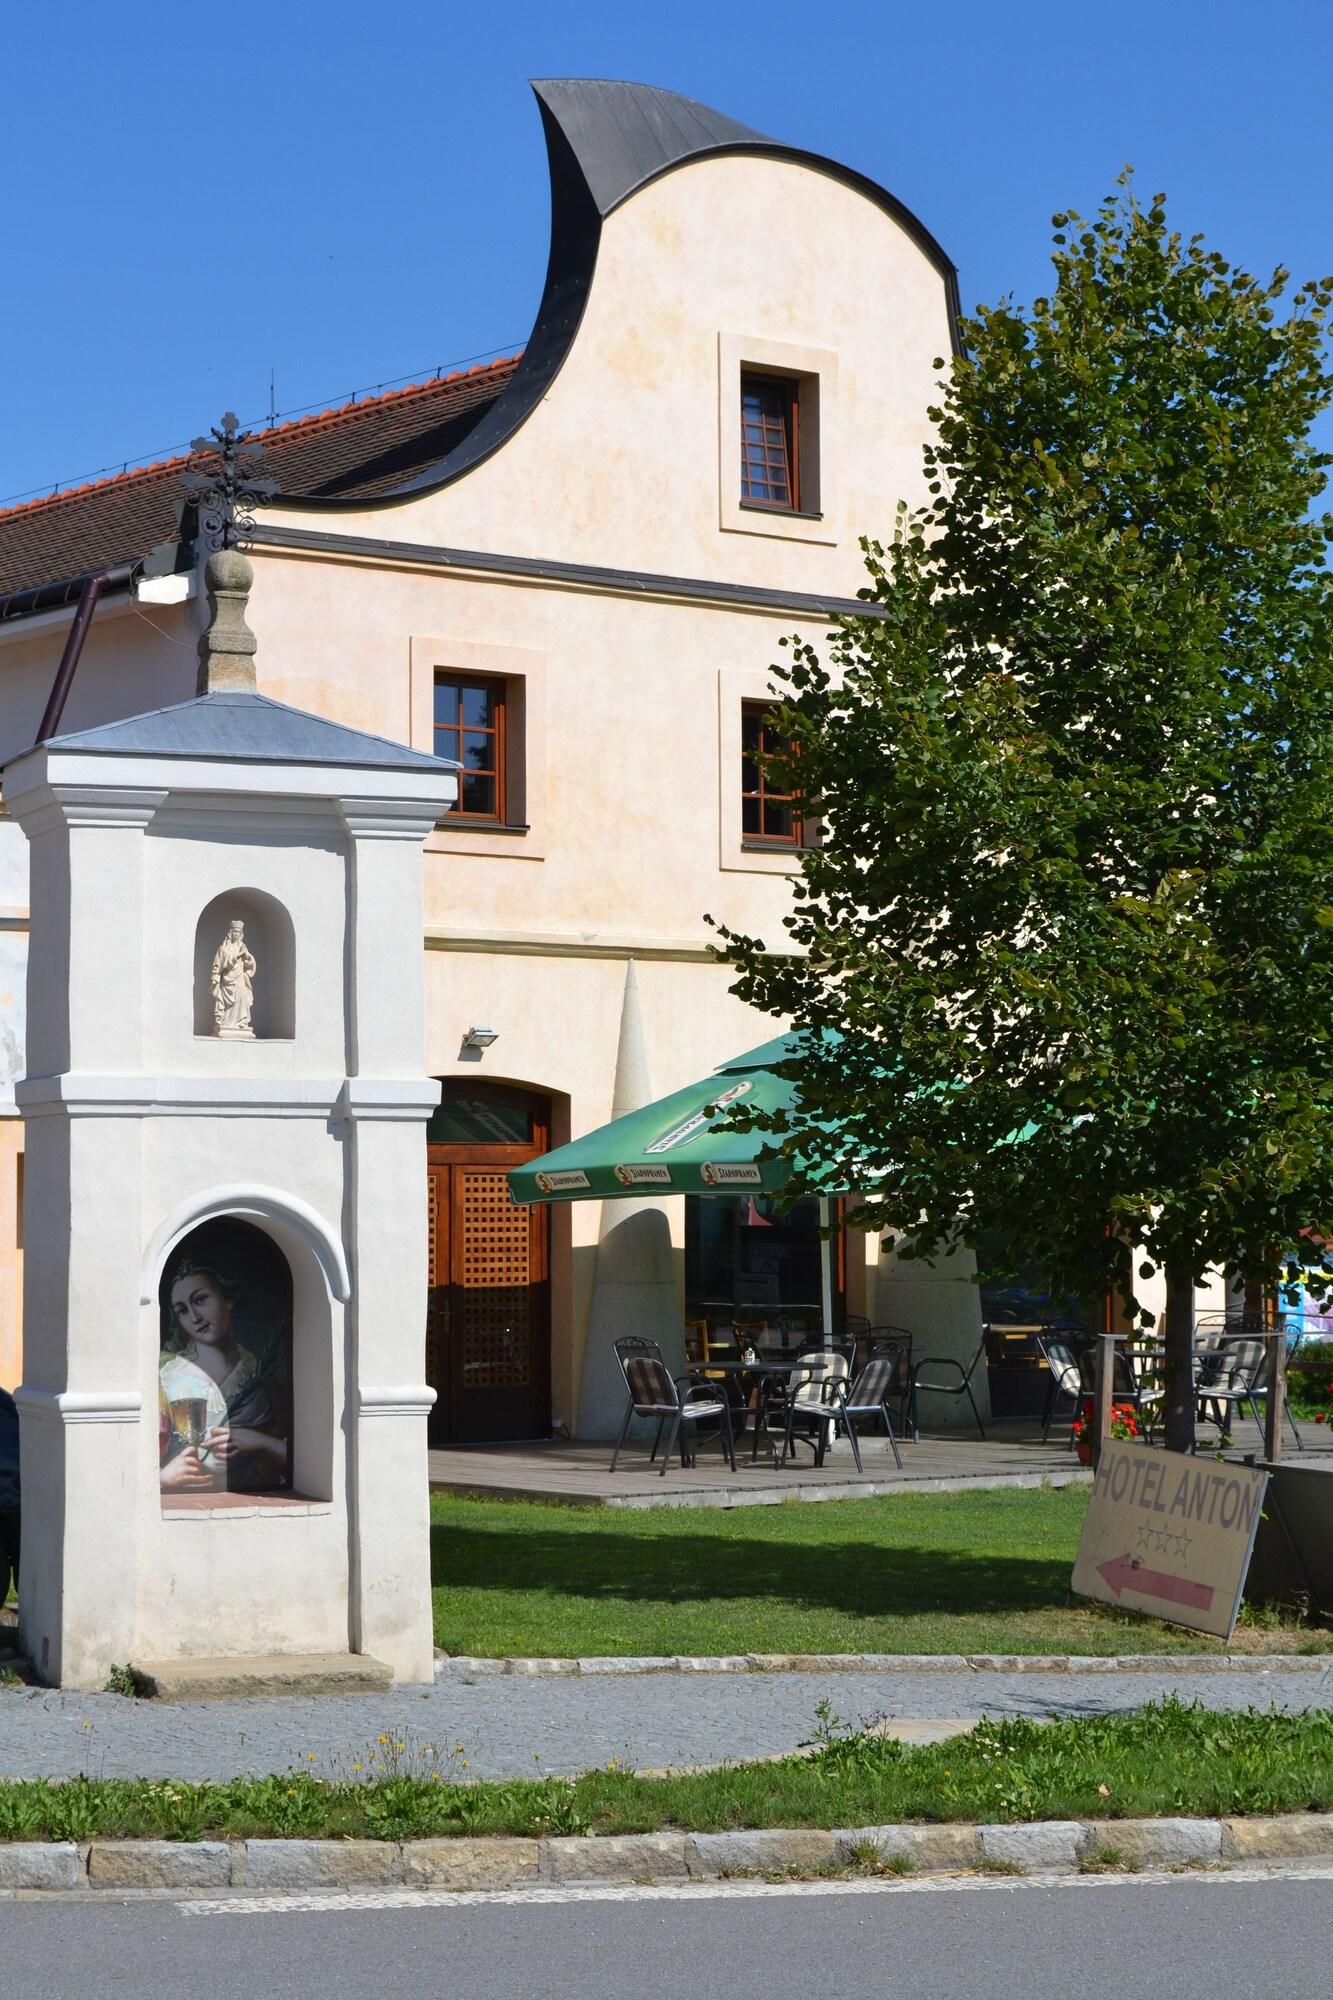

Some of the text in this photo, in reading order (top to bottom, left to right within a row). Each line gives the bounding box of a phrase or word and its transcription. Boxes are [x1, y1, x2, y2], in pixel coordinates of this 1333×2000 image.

[630, 1168, 667, 1179] STAROPRAMEN
[718, 1168, 758, 1178] STAROPRAMEN
[550, 1174, 586, 1186] STAROPRAMEN
[1094, 1452, 1166, 1512] HOTEL
